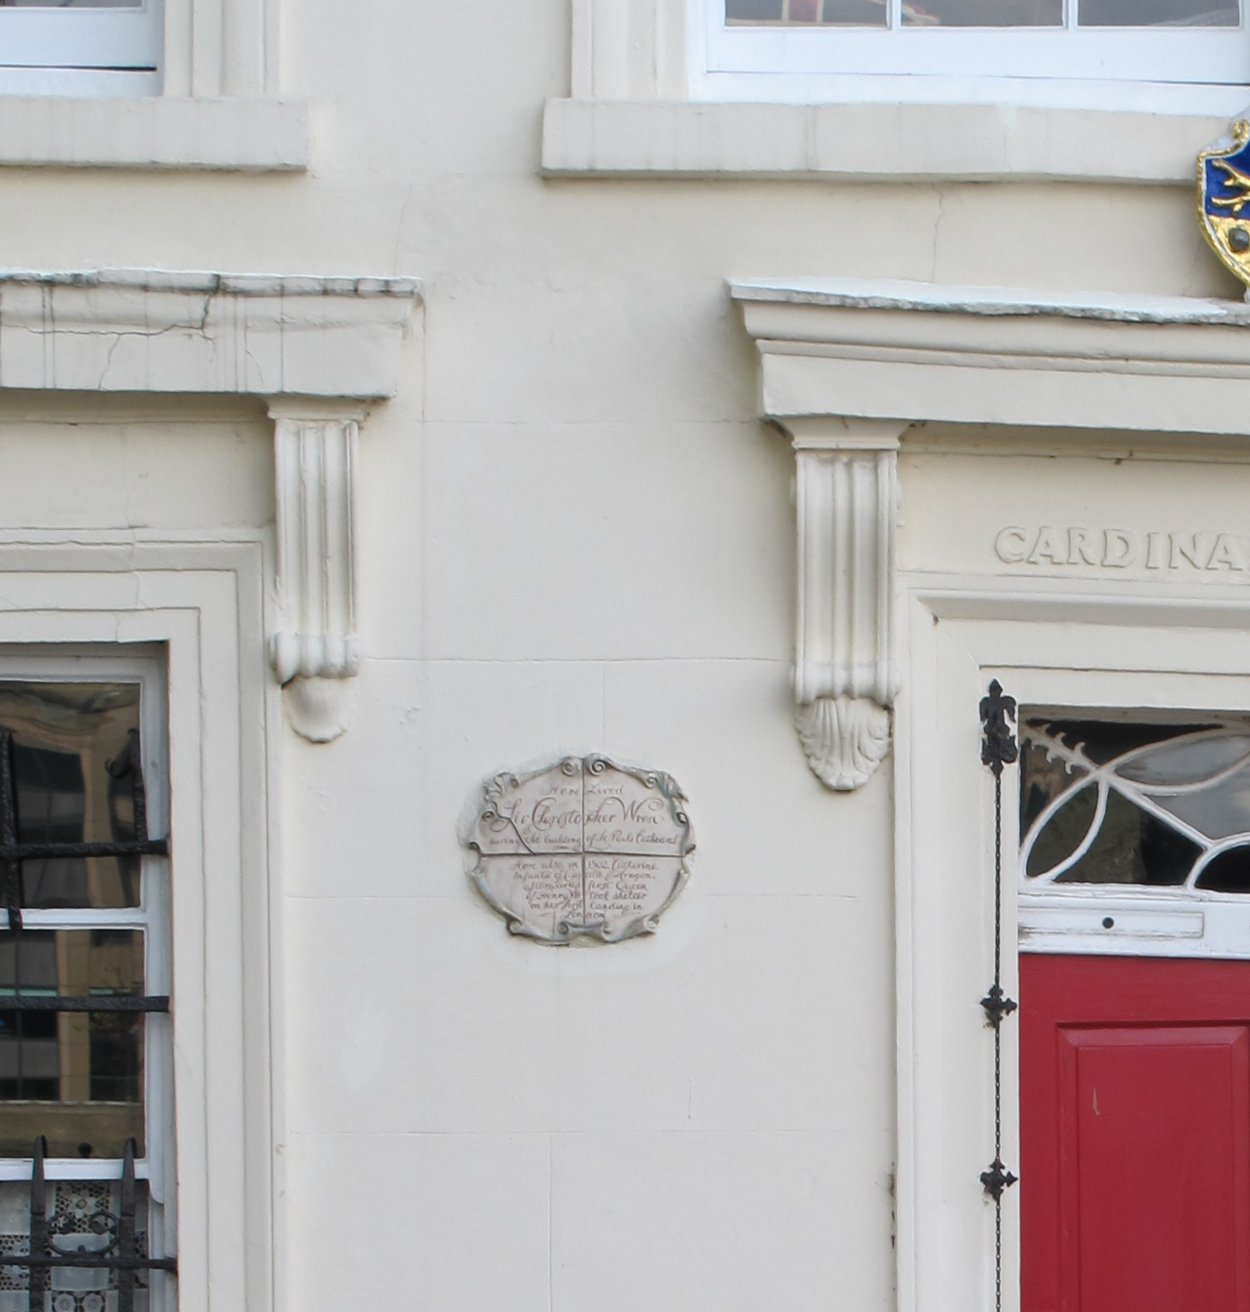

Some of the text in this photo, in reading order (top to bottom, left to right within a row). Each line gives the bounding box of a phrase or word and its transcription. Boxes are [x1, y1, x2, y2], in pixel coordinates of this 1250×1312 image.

[490, 796, 665, 832] Sir Christopher Wren
[489, 837, 522, 850] during
[544, 834, 581, 851] building
[586, 833, 597, 848] of
[636, 832, 679, 845] Cathedral
[615, 881, 647, 892] Queen
